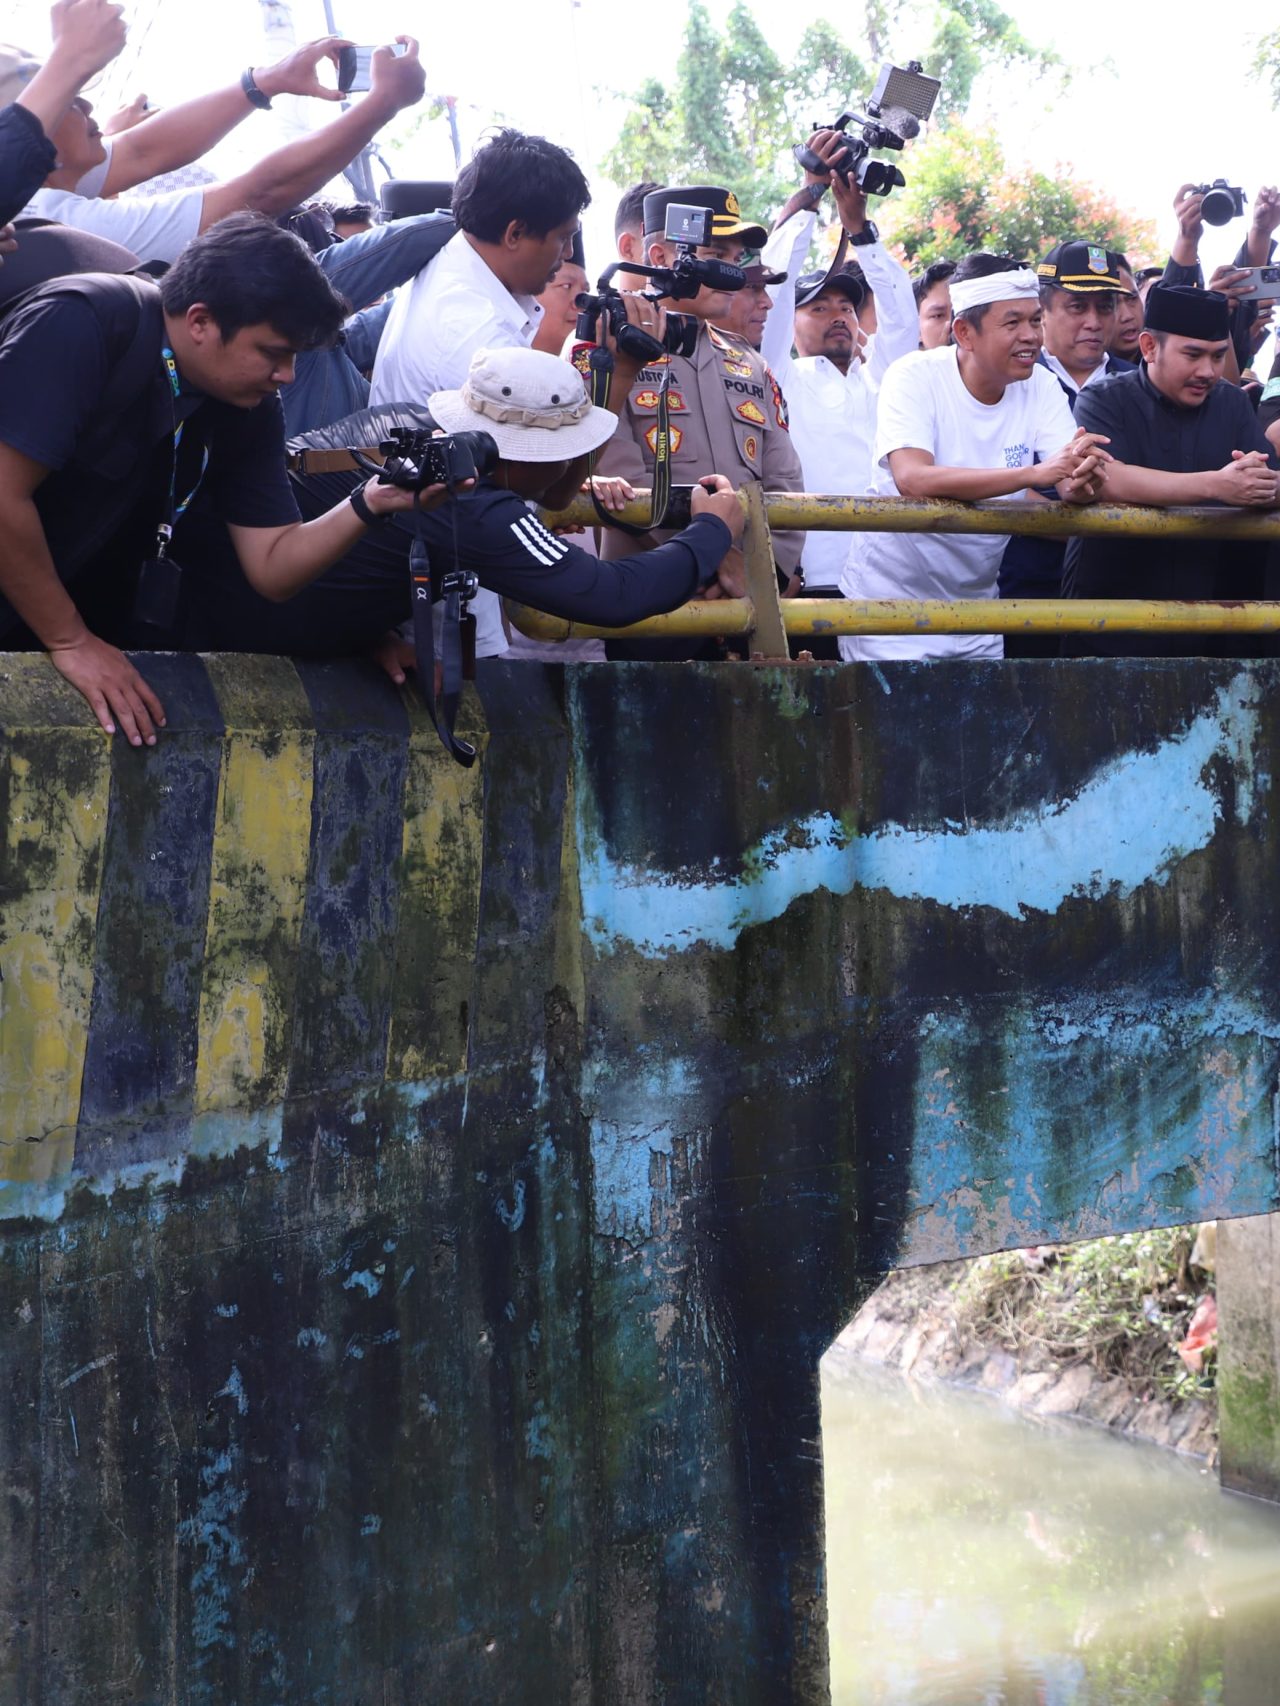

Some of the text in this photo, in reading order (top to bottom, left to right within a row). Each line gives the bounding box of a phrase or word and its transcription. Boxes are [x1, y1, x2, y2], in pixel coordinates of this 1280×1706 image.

[634, 370, 679, 385] USTOA
[723, 379, 764, 401] POLRI
[658, 432, 667, 462] Nikon
